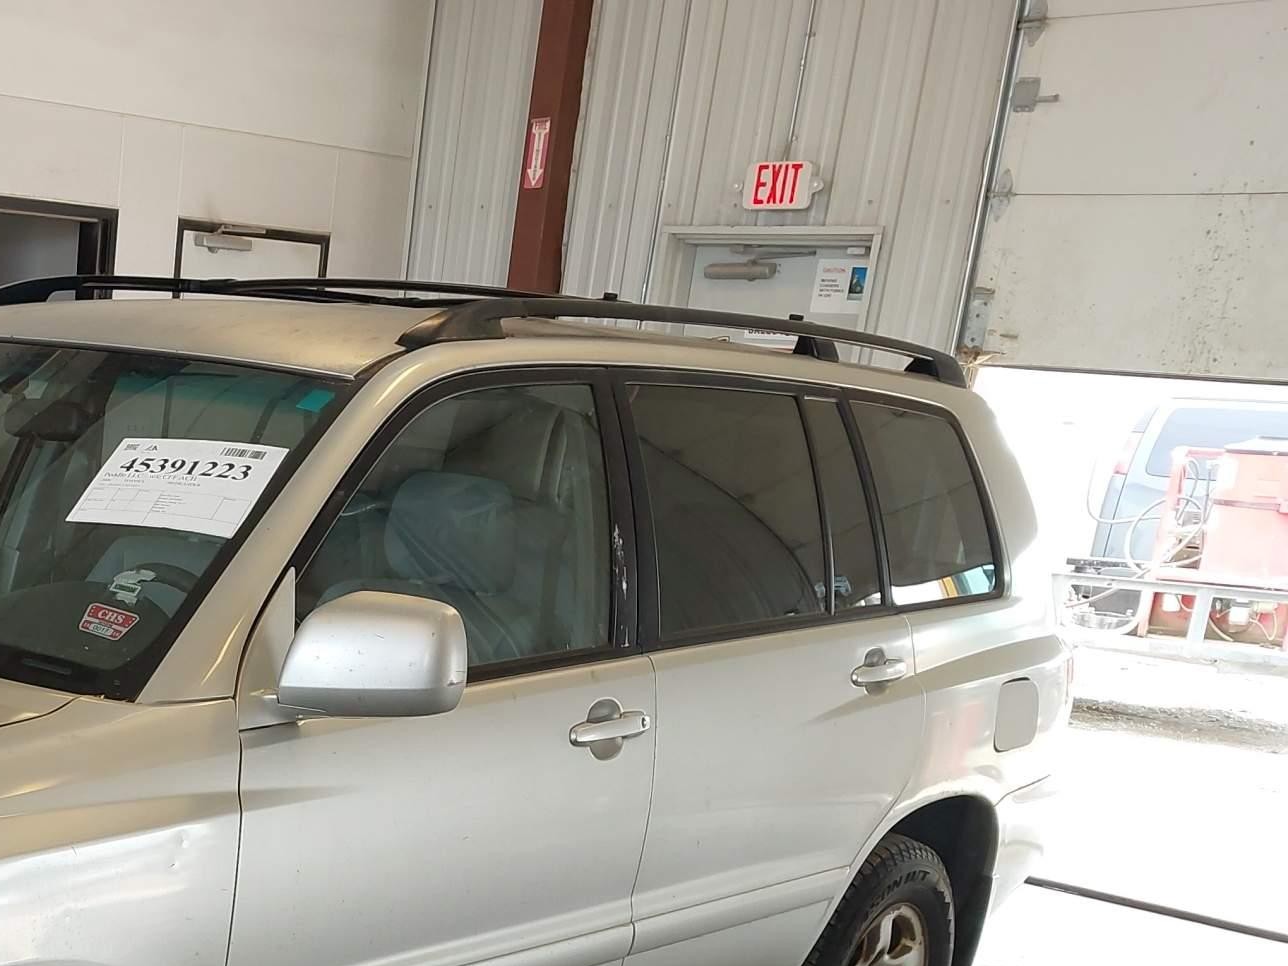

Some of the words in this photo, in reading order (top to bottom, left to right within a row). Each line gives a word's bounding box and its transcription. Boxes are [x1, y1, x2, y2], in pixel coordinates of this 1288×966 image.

[753, 163, 803, 204] EXIT
[120, 457, 252, 481] 45391223
[98, 609, 126, 624] CHS
